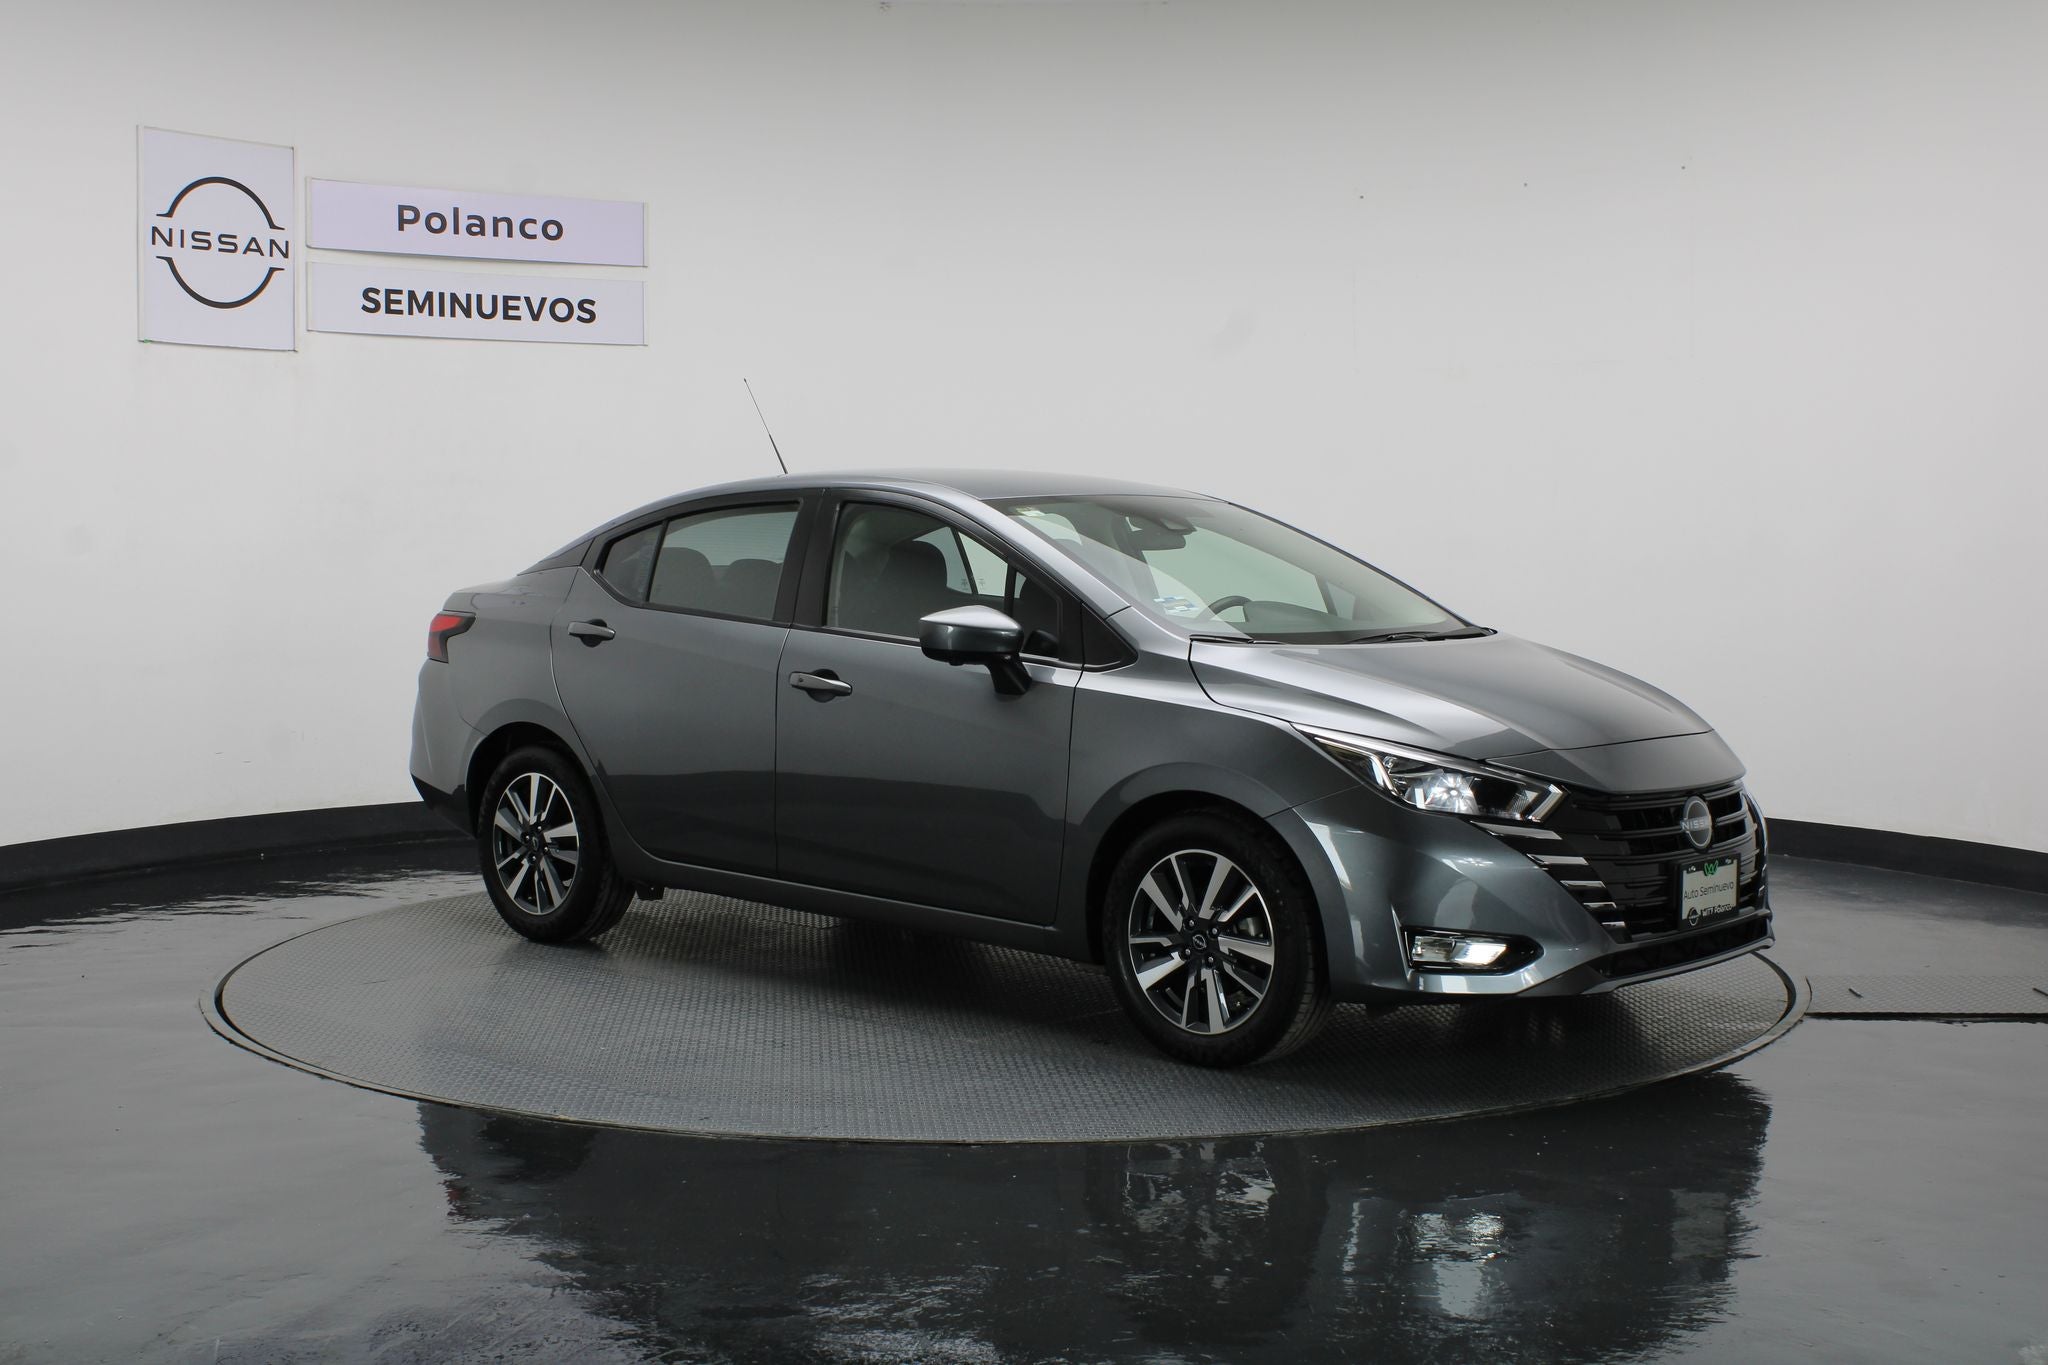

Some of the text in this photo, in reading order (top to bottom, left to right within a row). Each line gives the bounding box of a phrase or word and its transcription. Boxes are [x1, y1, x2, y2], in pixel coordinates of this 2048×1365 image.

[397, 204, 564, 241] Polanco
[152, 225, 289, 259] NISSAN
[361, 287, 597, 324] SEMINUEVOS
[1681, 818, 1709, 830] NISS
[1684, 881, 1734, 901] Auto Seminuevo
